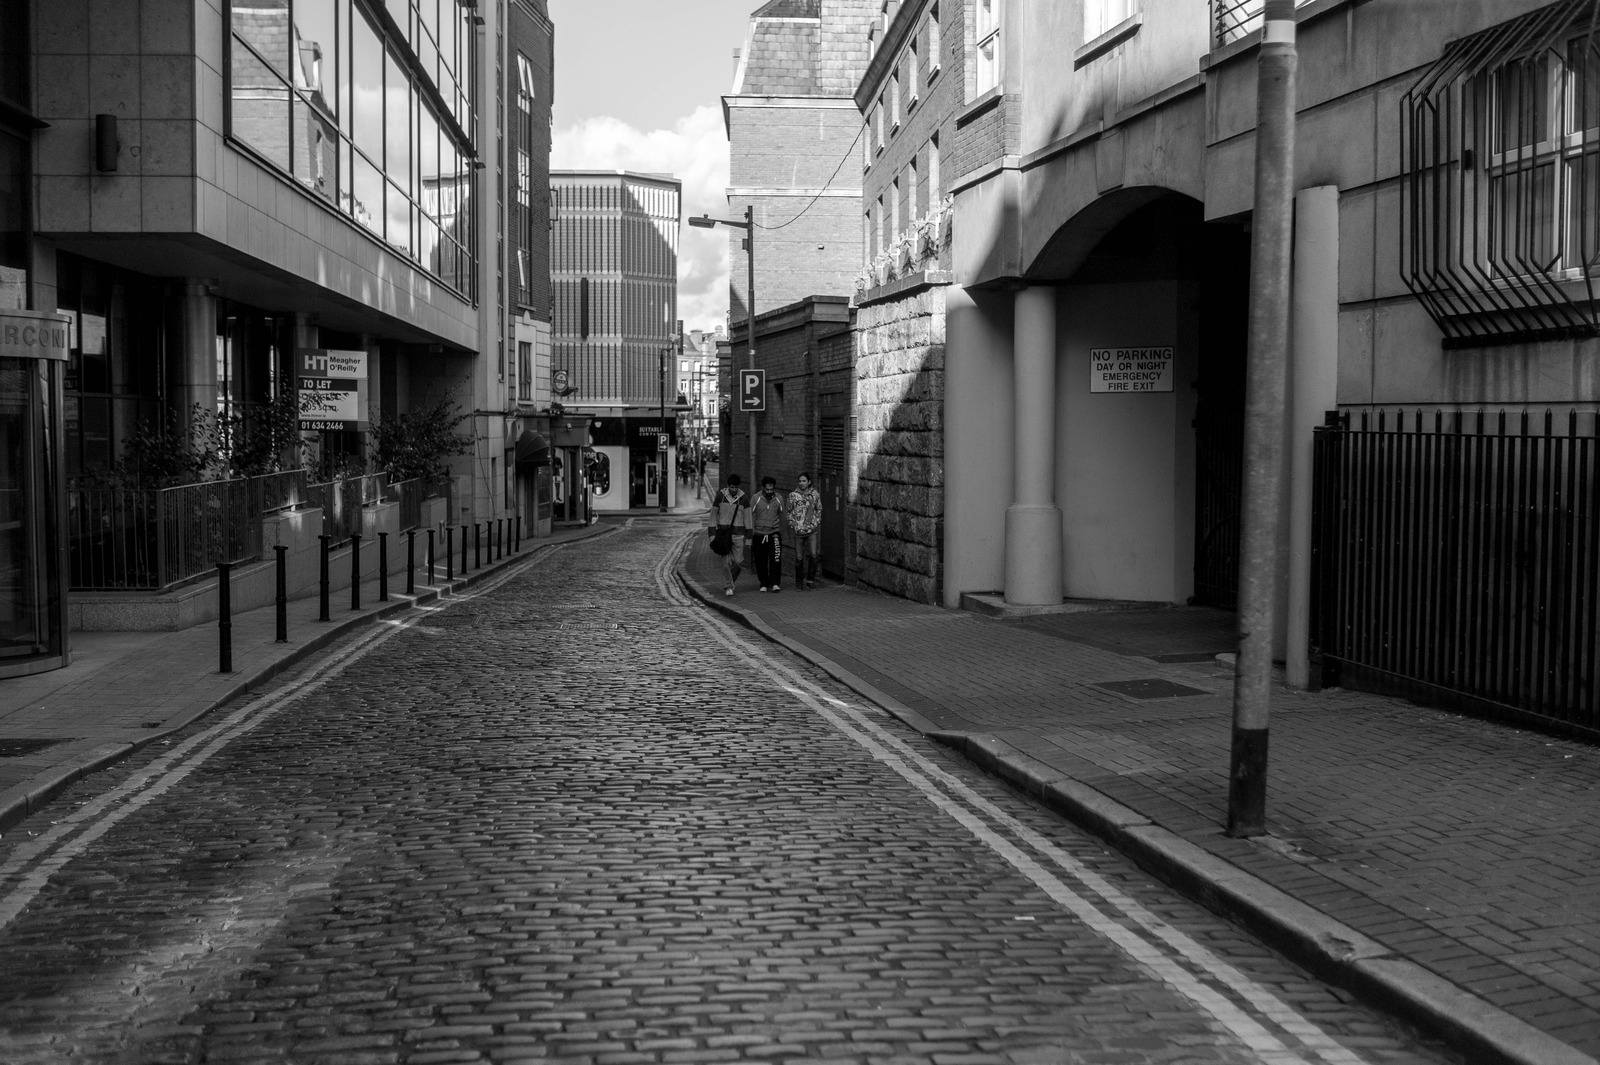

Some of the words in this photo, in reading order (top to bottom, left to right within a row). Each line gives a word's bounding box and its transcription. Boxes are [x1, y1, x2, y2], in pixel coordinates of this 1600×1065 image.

[0, 324, 65, 349] RCONI
[1092, 350, 1111, 361] NO
[1117, 349, 1172, 361] PARKING
[304, 355, 328, 370] HT
[1096, 362, 1115, 371] DAY
[1118, 362, 1132, 371] OR
[1137, 361, 1168, 370] NIGHT
[329, 364, 358, 372] O'Reilly
[1102, 371, 1162, 381] EMERGENCY
[303, 379, 314, 388] TO
[316, 380, 332, 389] LET
[745, 374, 760, 394] P
[1108, 382, 1129, 391] FIRE
[1133, 381, 1155, 390] EXIT
[301, 421, 310, 429] 01
[311, 421, 325, 430] 634
[326, 421, 344, 430] 2466
[660, 435, 667, 444] P
